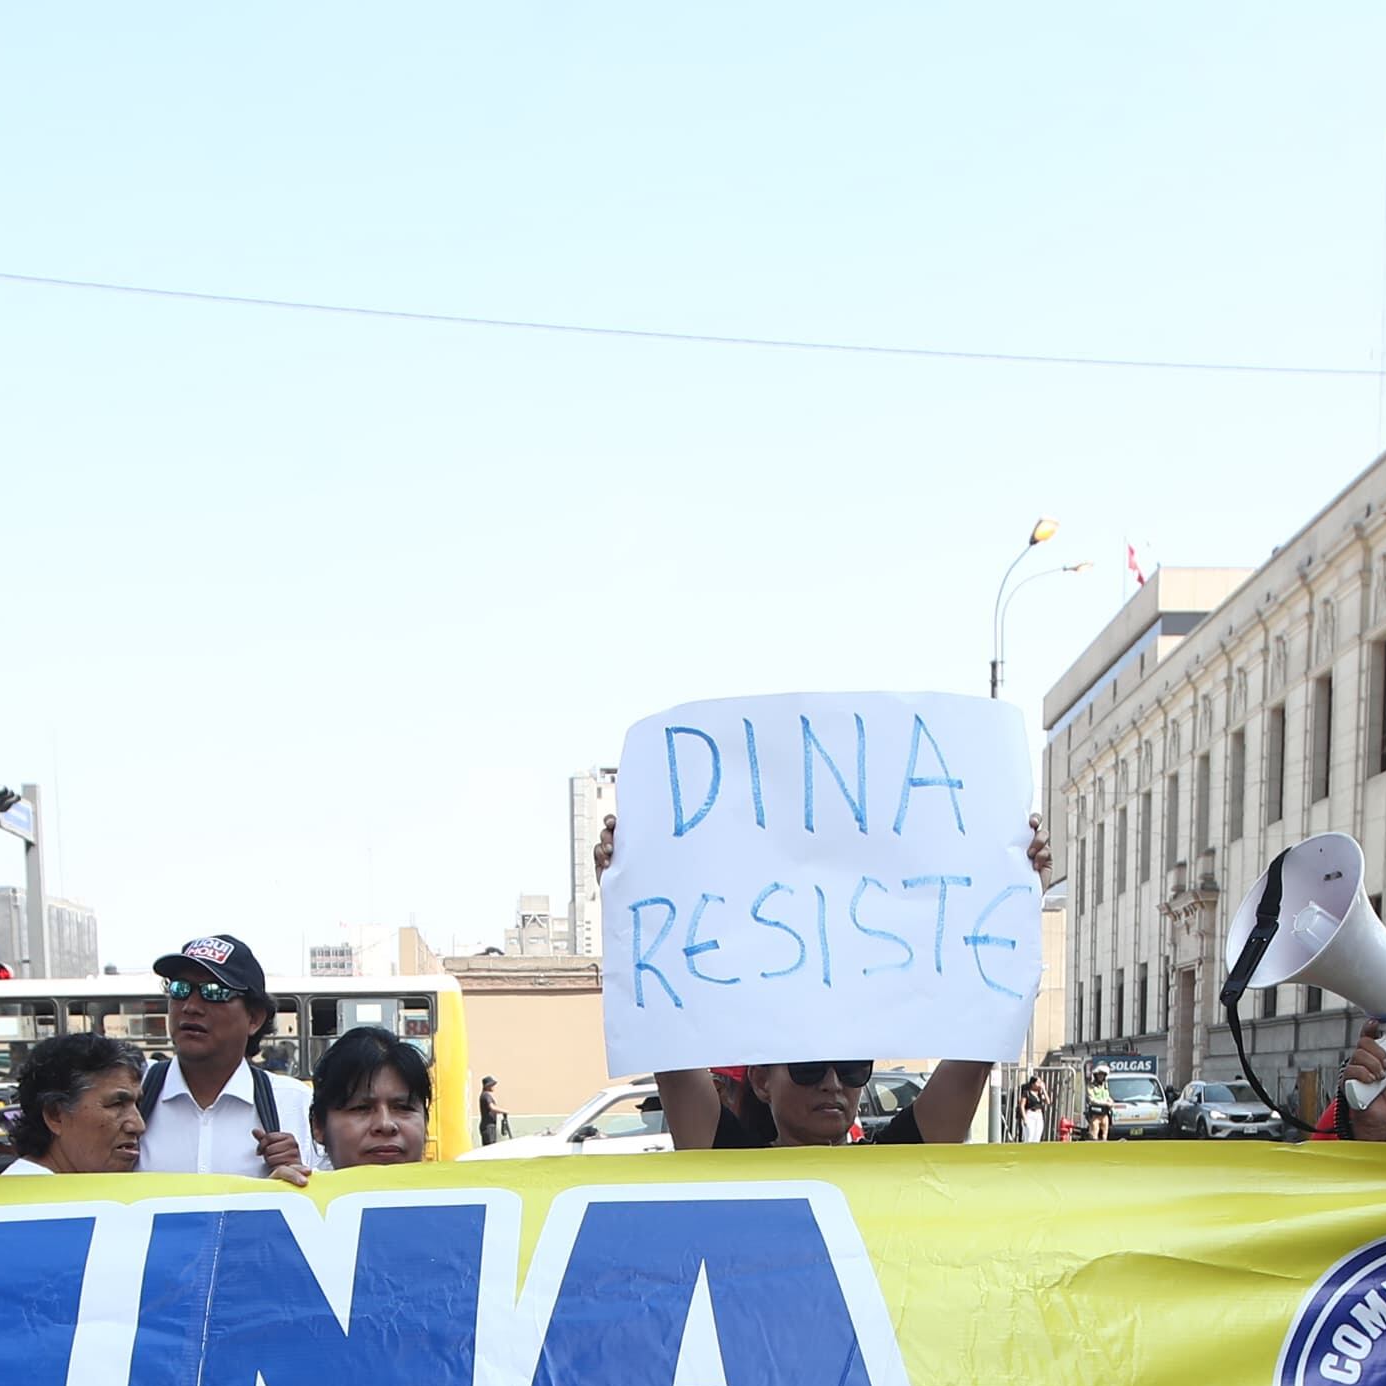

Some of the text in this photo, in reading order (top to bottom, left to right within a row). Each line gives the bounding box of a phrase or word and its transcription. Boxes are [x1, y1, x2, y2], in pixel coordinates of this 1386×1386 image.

[666, 713, 966, 838] DINA
[192, 939, 230, 953] LIQUI
[628, 875, 1033, 1010] RESISTE
[187, 947, 225, 960] MOLY
[1109, 1060, 1152, 1072] SOLGAS
